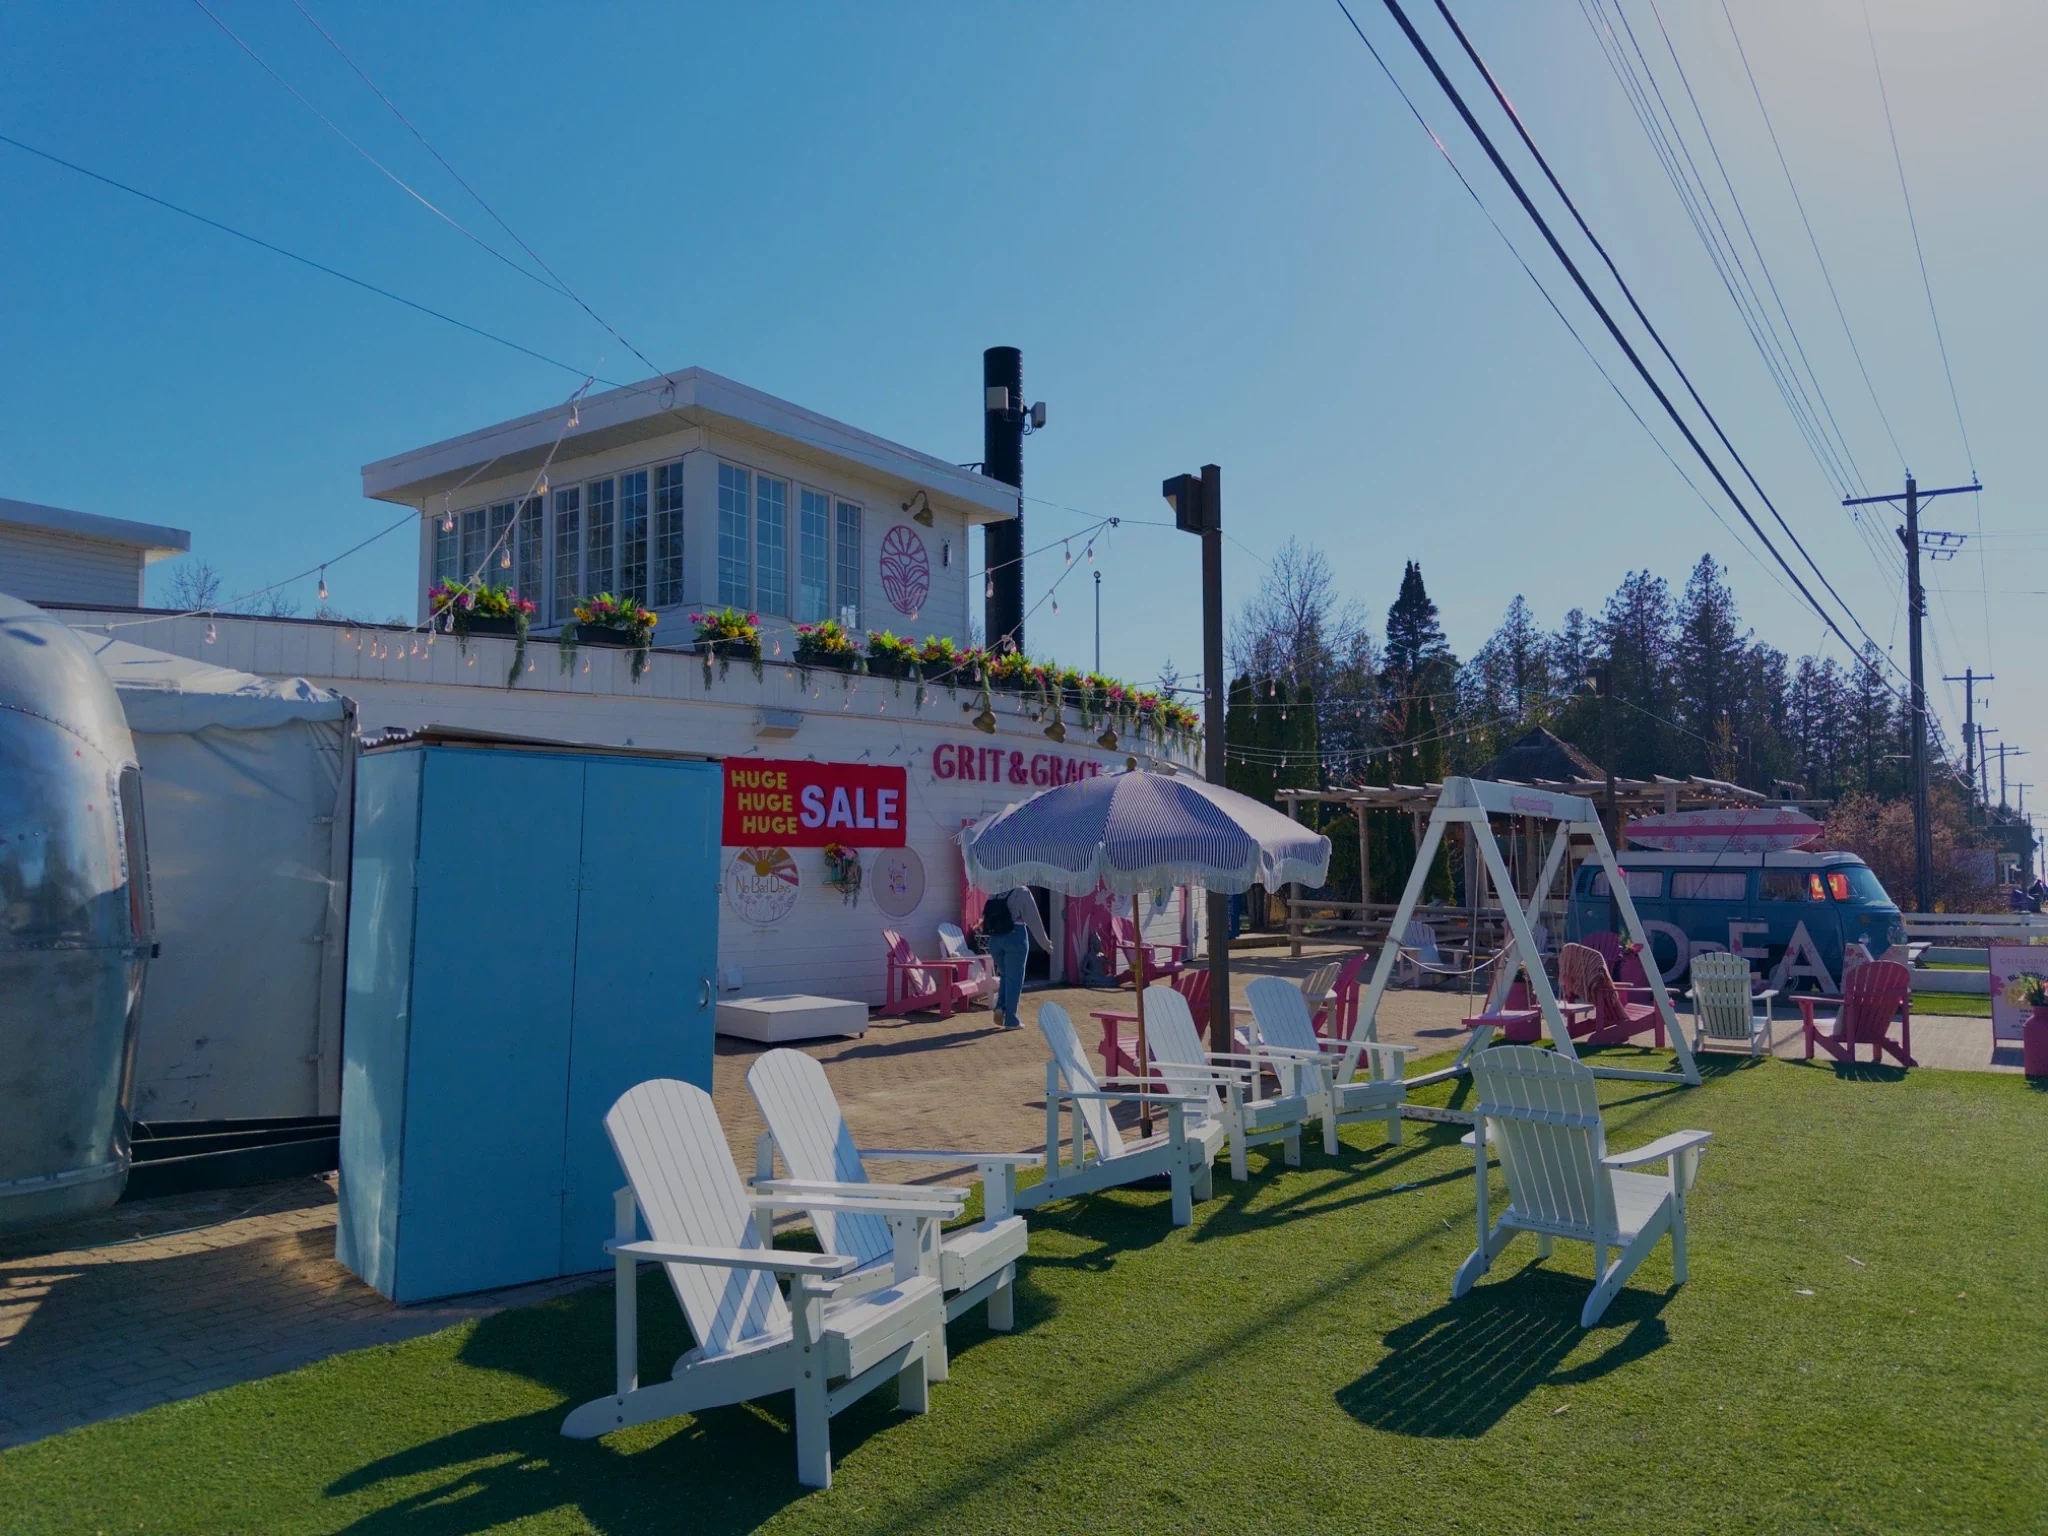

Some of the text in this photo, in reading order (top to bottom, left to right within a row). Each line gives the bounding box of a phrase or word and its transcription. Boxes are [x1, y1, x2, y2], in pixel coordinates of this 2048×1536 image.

[731, 769, 788, 790] HUGE
[738, 792, 793, 812] HUGE
[800, 784, 899, 829] SALE
[742, 815, 798, 835] HUGE
[735, 874, 791, 895] No Bad Days
[1640, 919, 1909, 1001] DEA
